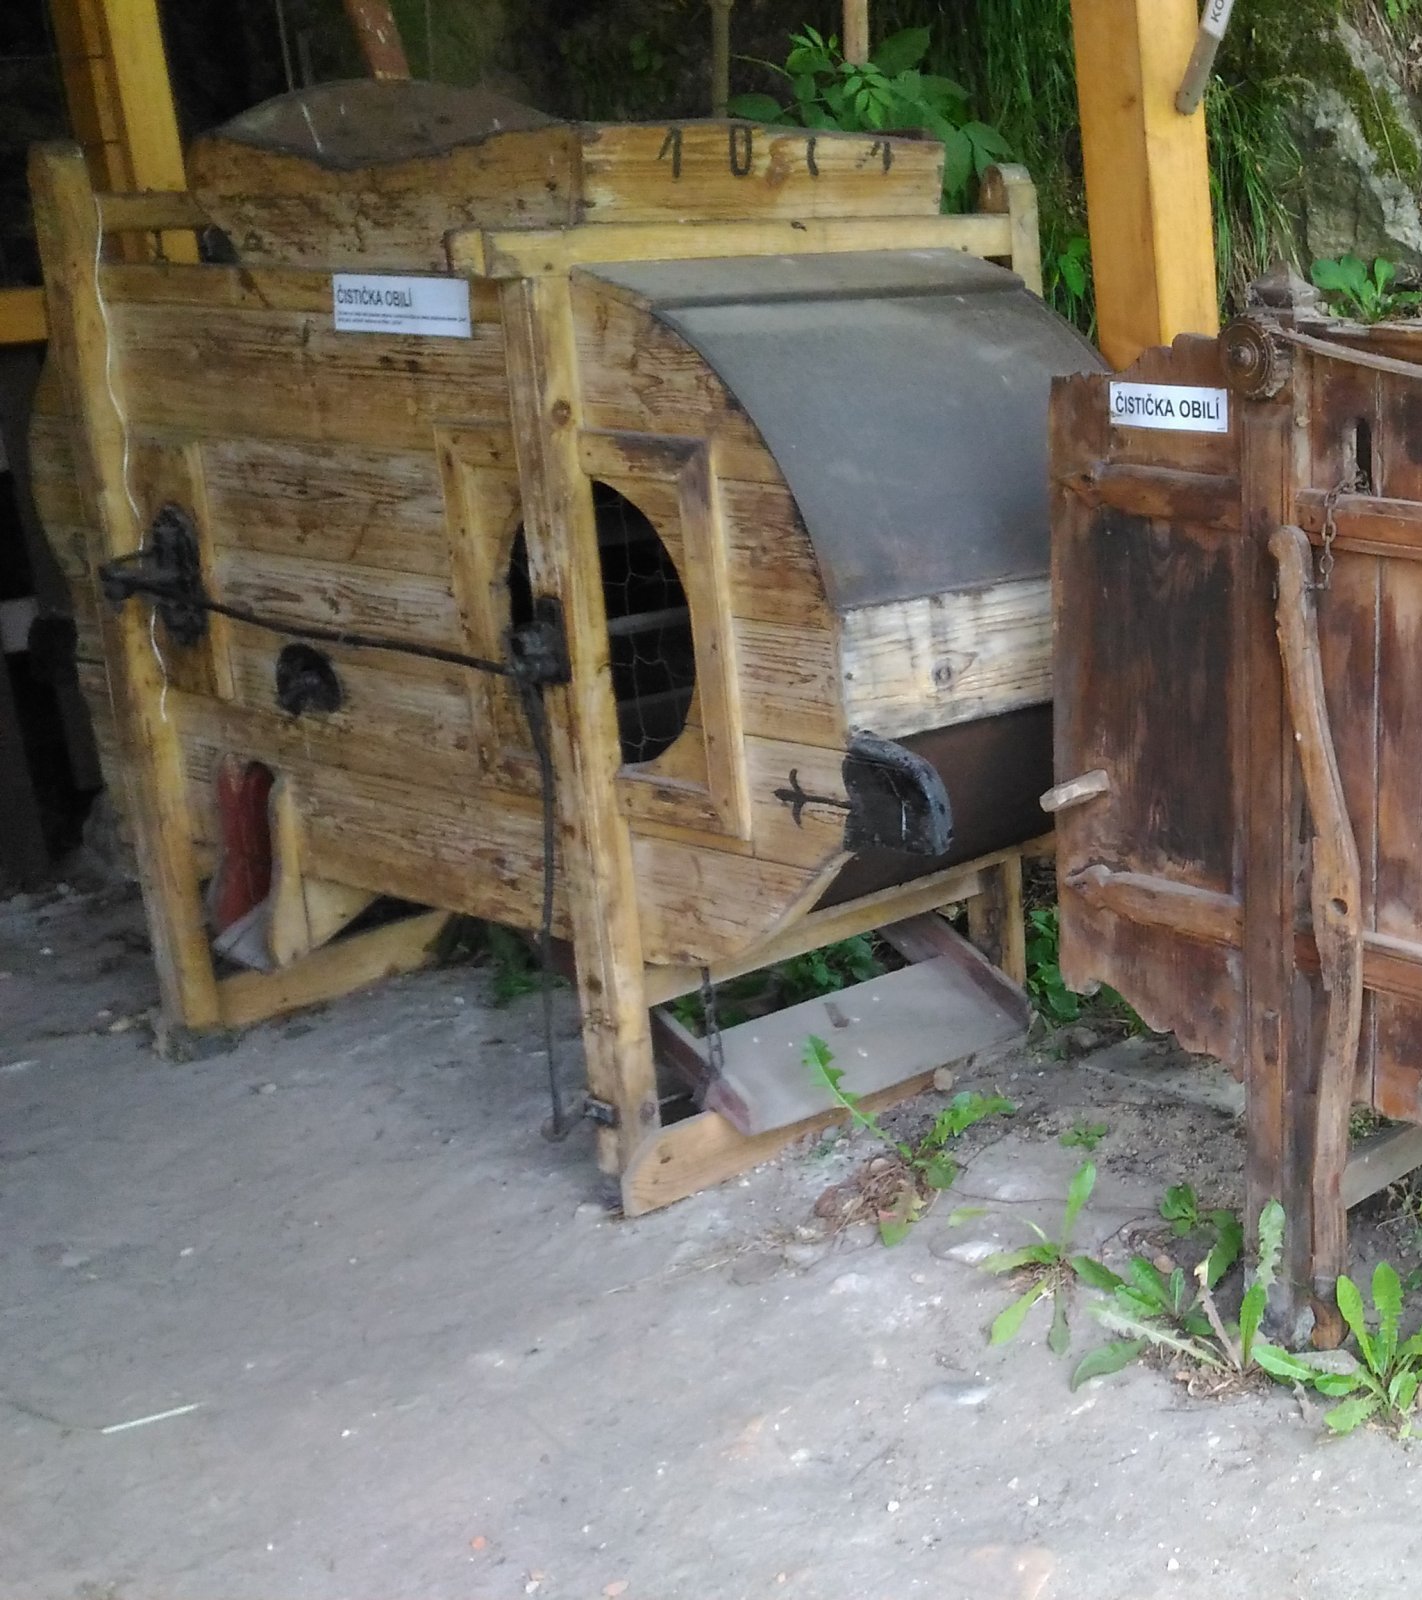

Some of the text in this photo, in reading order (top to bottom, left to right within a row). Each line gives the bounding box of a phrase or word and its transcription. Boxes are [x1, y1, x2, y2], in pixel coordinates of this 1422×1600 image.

[336, 285, 413, 308] ČISTIČKA OBILÍ
[1115, 391, 1220, 420] ČISTIČKA OBILÍ
